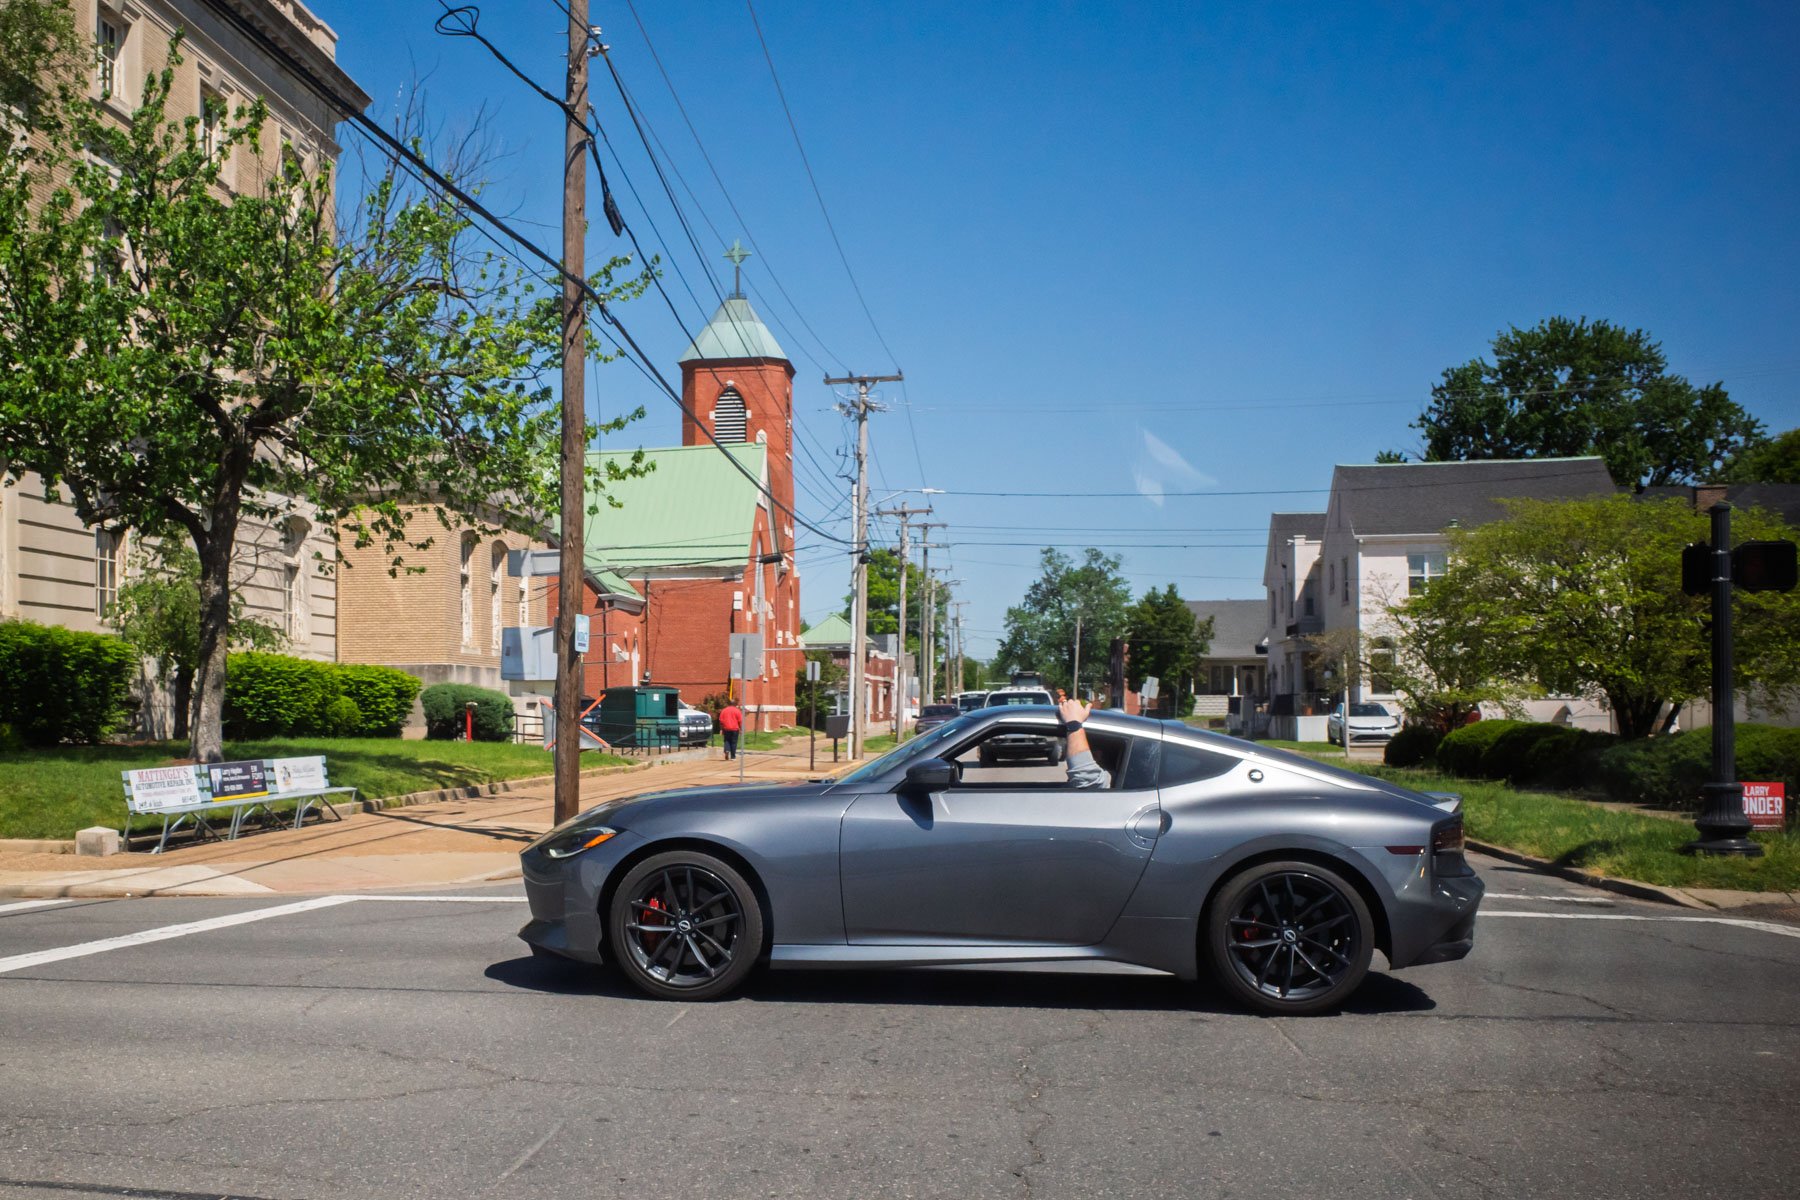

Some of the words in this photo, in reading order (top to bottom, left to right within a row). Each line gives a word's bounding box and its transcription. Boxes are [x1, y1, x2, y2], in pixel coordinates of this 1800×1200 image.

[137, 768, 189, 783] MATTINGLY'S
[135, 781, 167, 790] AUTOMOTIVE
[1744, 785, 1769, 796] LARRY
